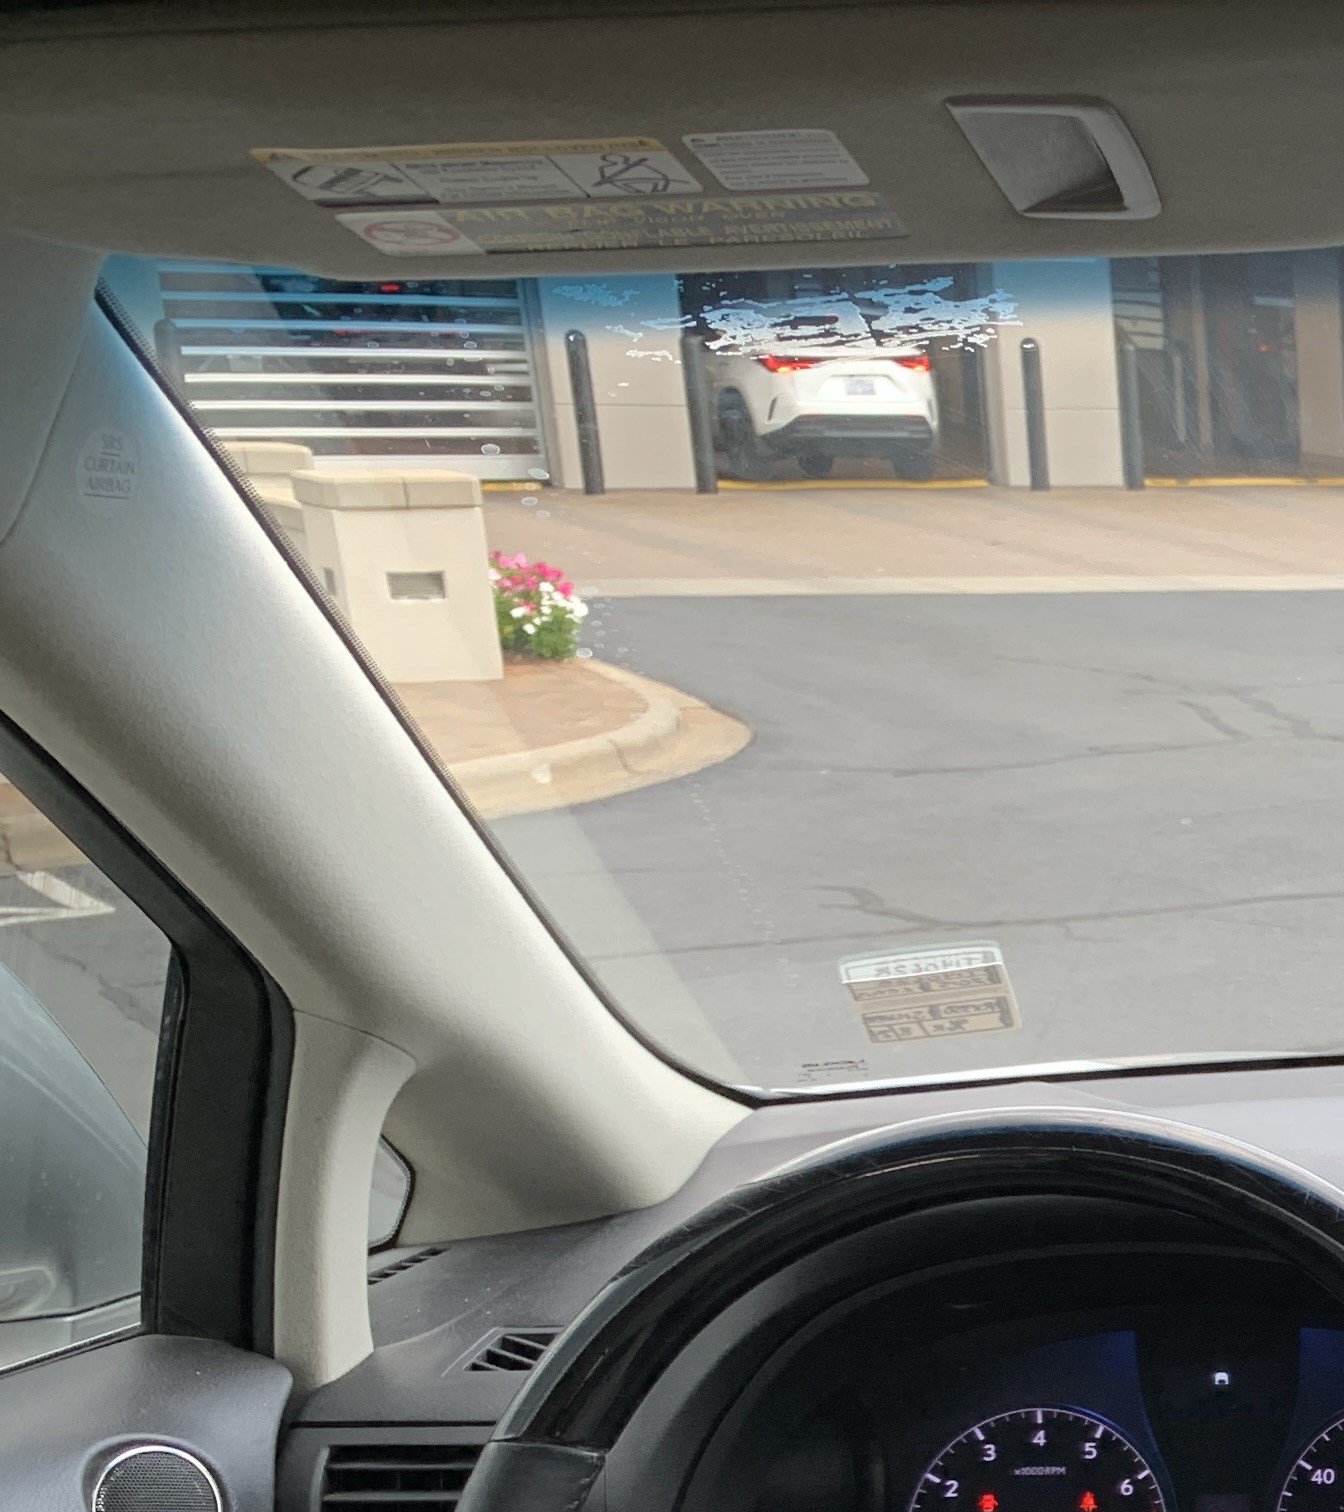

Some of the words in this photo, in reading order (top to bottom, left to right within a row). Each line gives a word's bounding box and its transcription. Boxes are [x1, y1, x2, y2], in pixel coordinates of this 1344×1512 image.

[455, 206, 529, 222] AIR
[546, 203, 644, 219] BAG
[652, 192, 876, 213] WARNING
[84, 456, 136, 475] CURTAIN
[87, 476, 131, 493] AIRBAG
[1032, 1429, 1046, 1446] 4
[982, 1444, 997, 1461] 3
[1083, 1442, 1098, 1459] 5
[1311, 1468, 1335, 1484] 40
[944, 1480, 959, 1498] 2
[1120, 1479, 1134, 1496] 6
